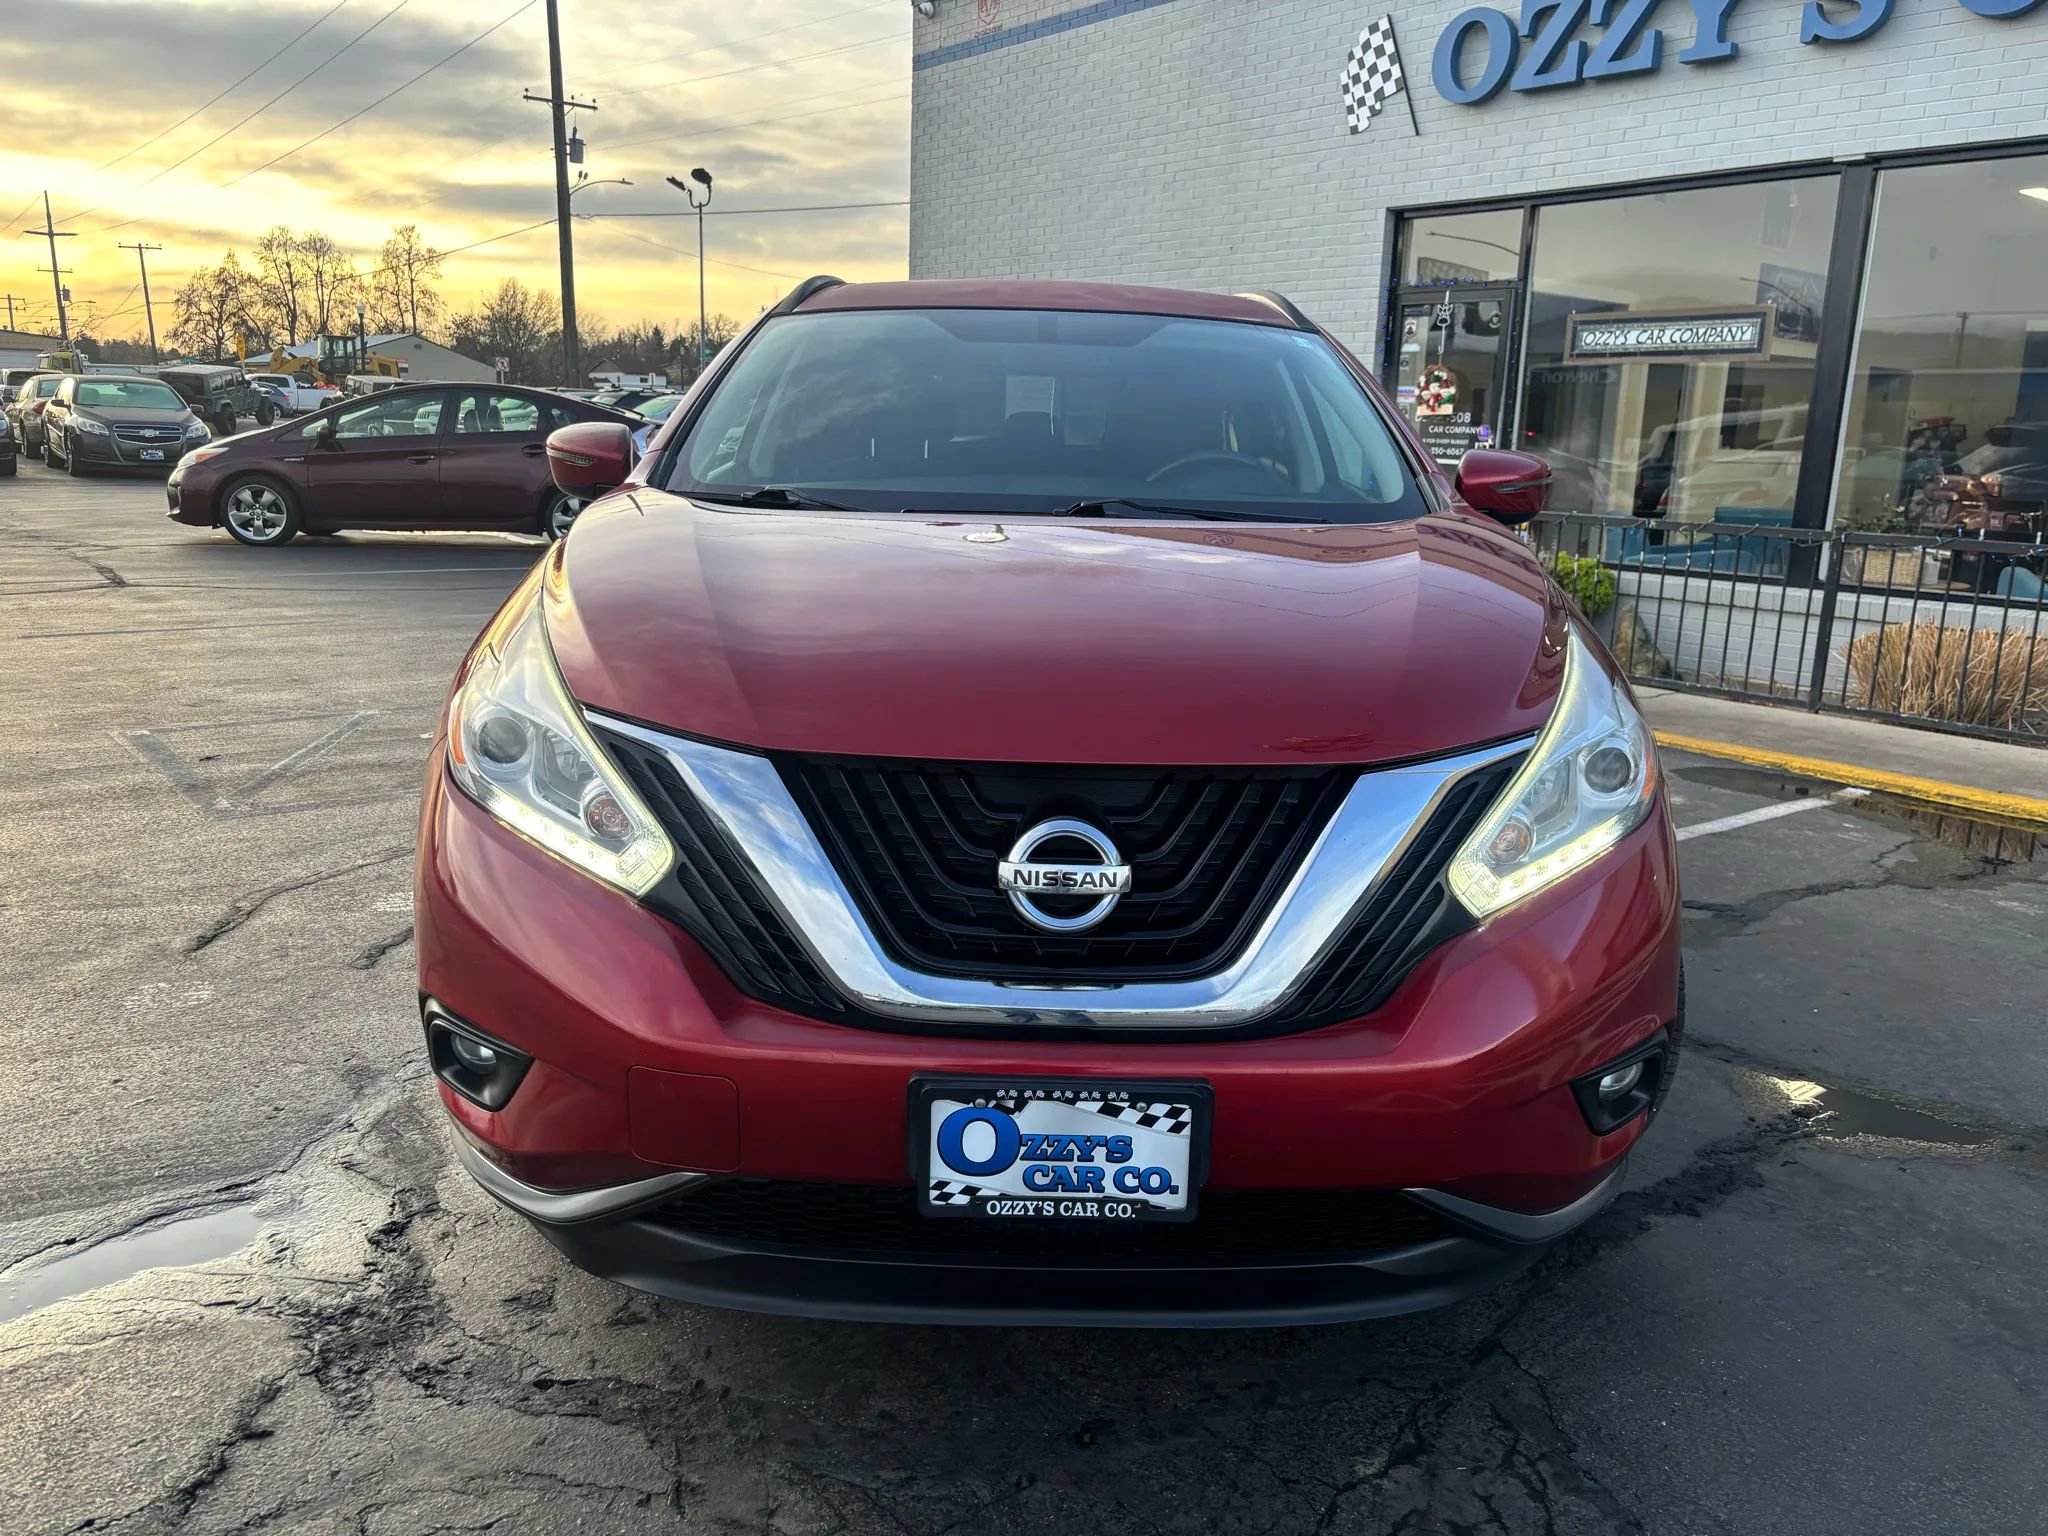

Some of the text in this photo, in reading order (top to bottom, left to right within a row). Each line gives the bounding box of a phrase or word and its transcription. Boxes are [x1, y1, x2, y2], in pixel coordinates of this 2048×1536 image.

[1432, 0, 1894, 105] OZZY
[1636, 328, 1665, 344] CAR
[1669, 325, 1752, 344] COMPANY
[1428, 425, 1482, 434] CAR COMPANY
[1013, 869, 1118, 889] NISSAN
[937, 1106, 1134, 1177] OZZY'S
[1022, 1164, 1180, 1195] CAR CO.
[986, 1200, 1137, 1219] OZZY'S CAR CO.
